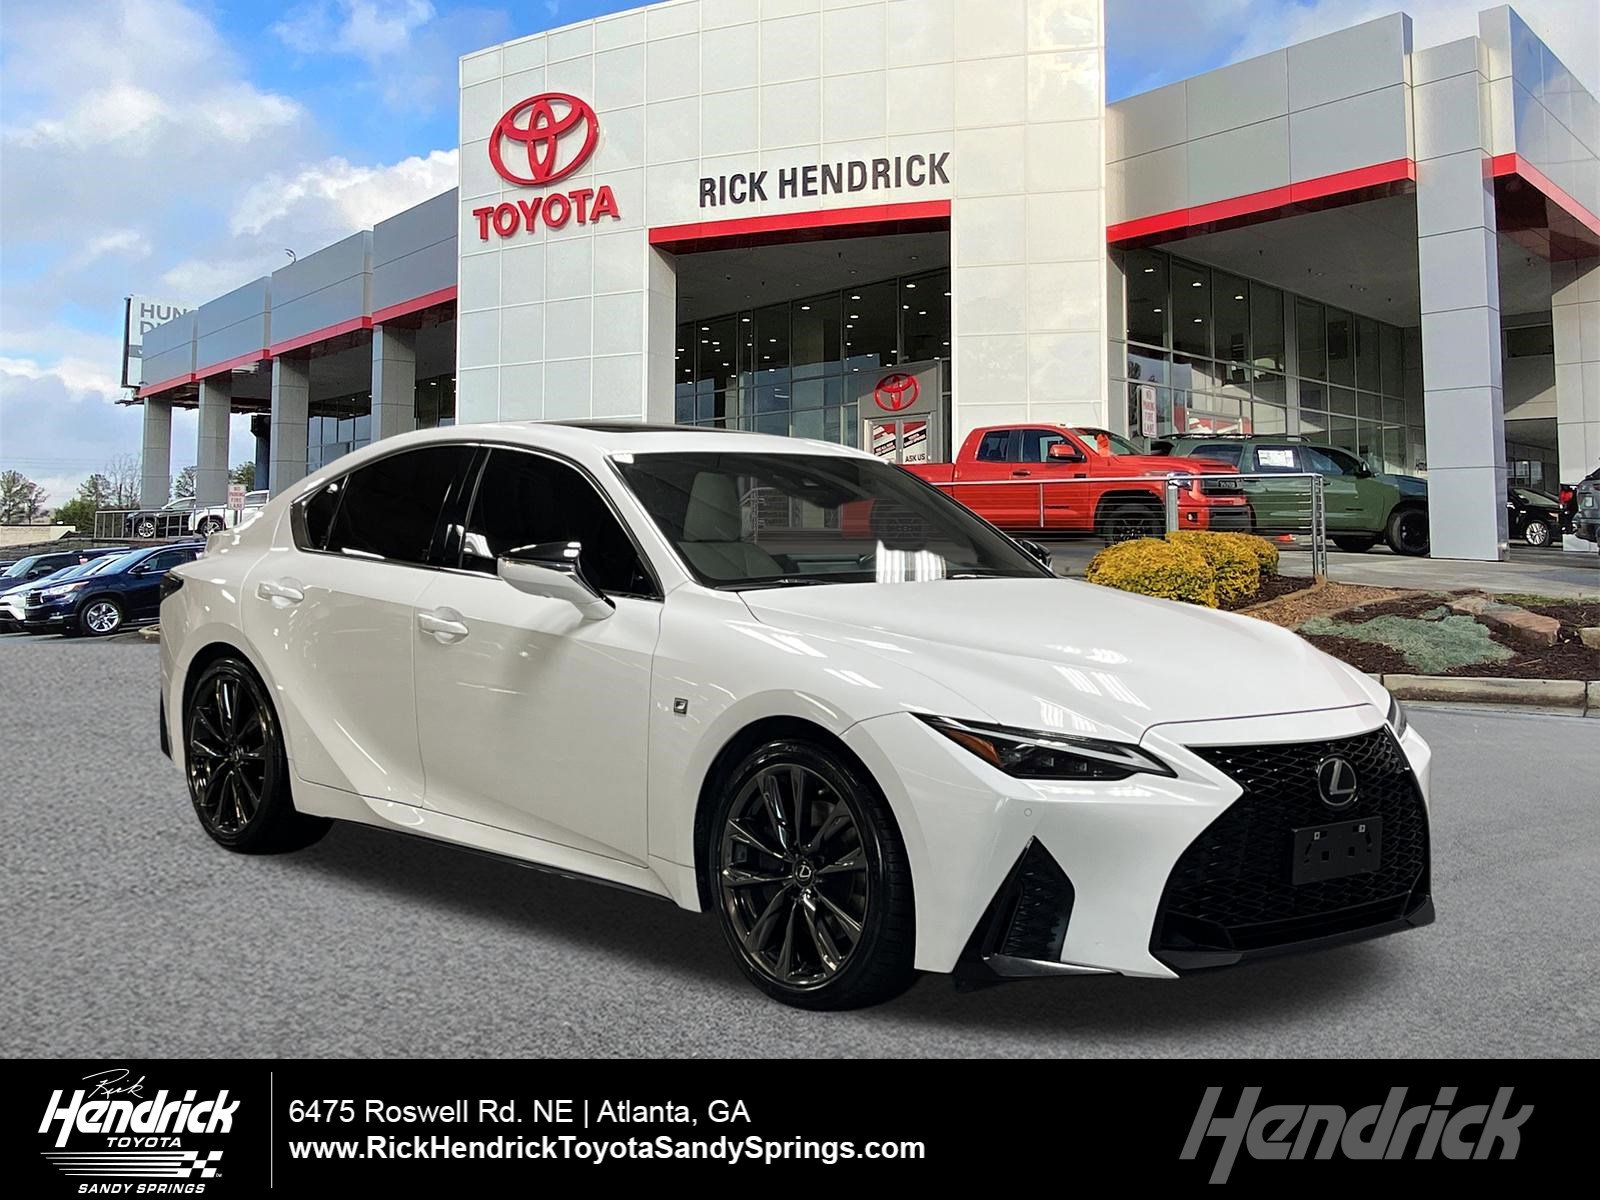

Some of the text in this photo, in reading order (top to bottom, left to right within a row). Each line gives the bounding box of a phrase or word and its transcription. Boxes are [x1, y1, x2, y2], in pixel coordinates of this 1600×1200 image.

[699, 152, 950, 208] RICK HENDRICK
[473, 185, 620, 240] TOYOTA
[905, 453, 926, 463] ASK US
